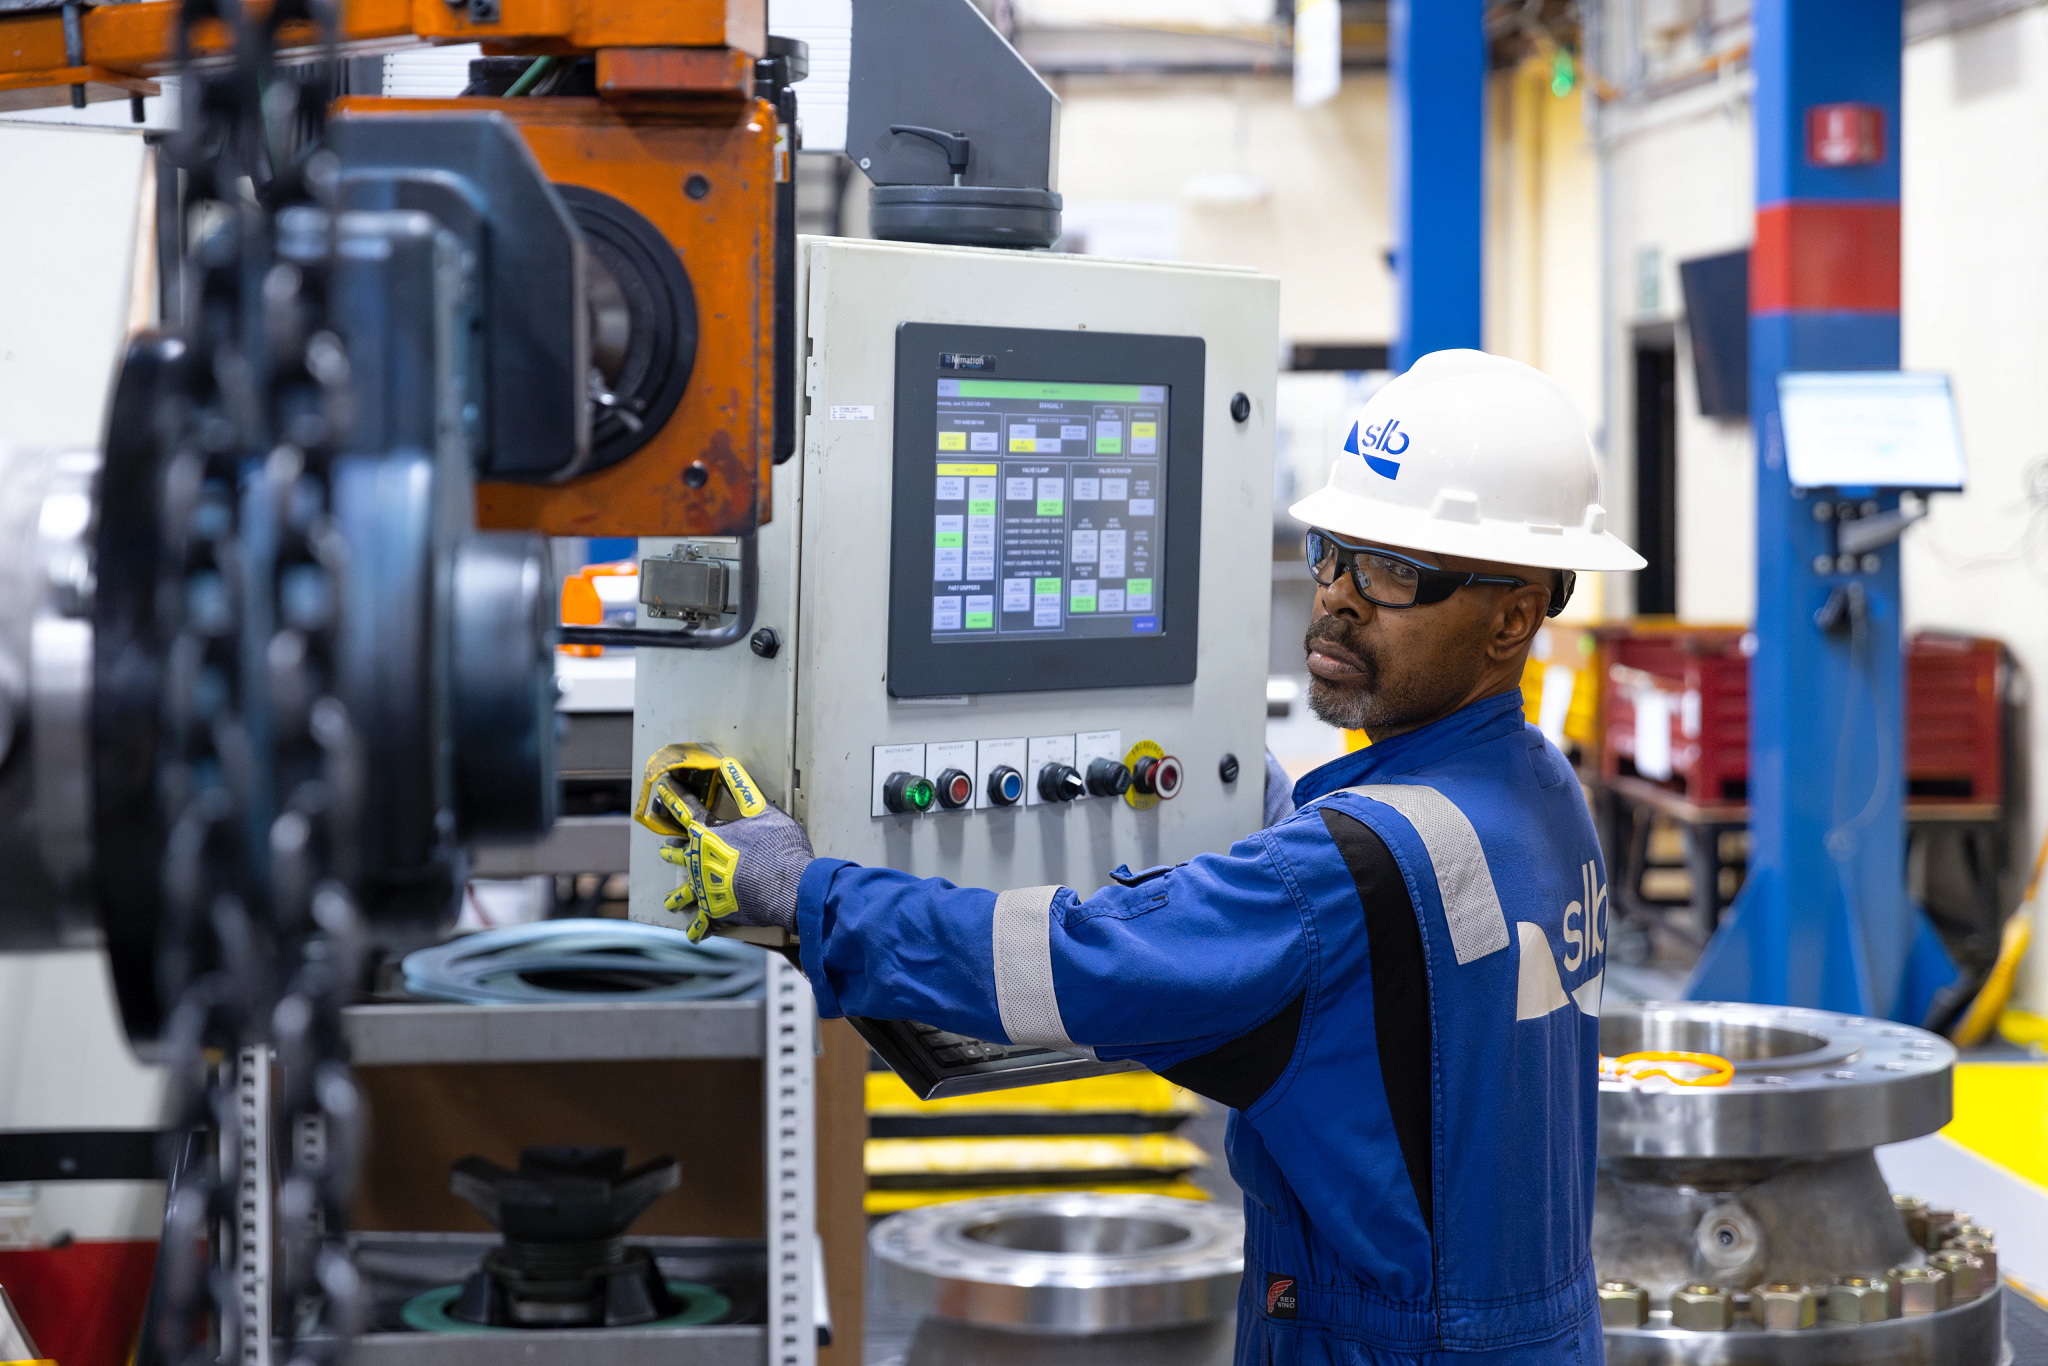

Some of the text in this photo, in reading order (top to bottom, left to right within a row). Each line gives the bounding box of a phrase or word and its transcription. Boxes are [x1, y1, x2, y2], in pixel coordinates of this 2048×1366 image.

[951, 355, 984, 365] Nematron
[1362, 419, 1410, 455] slb
[1131, 740, 1164, 757] EMERGENCY
[726, 765, 756, 809] HexArmor
[1563, 860, 1608, 972] slb
